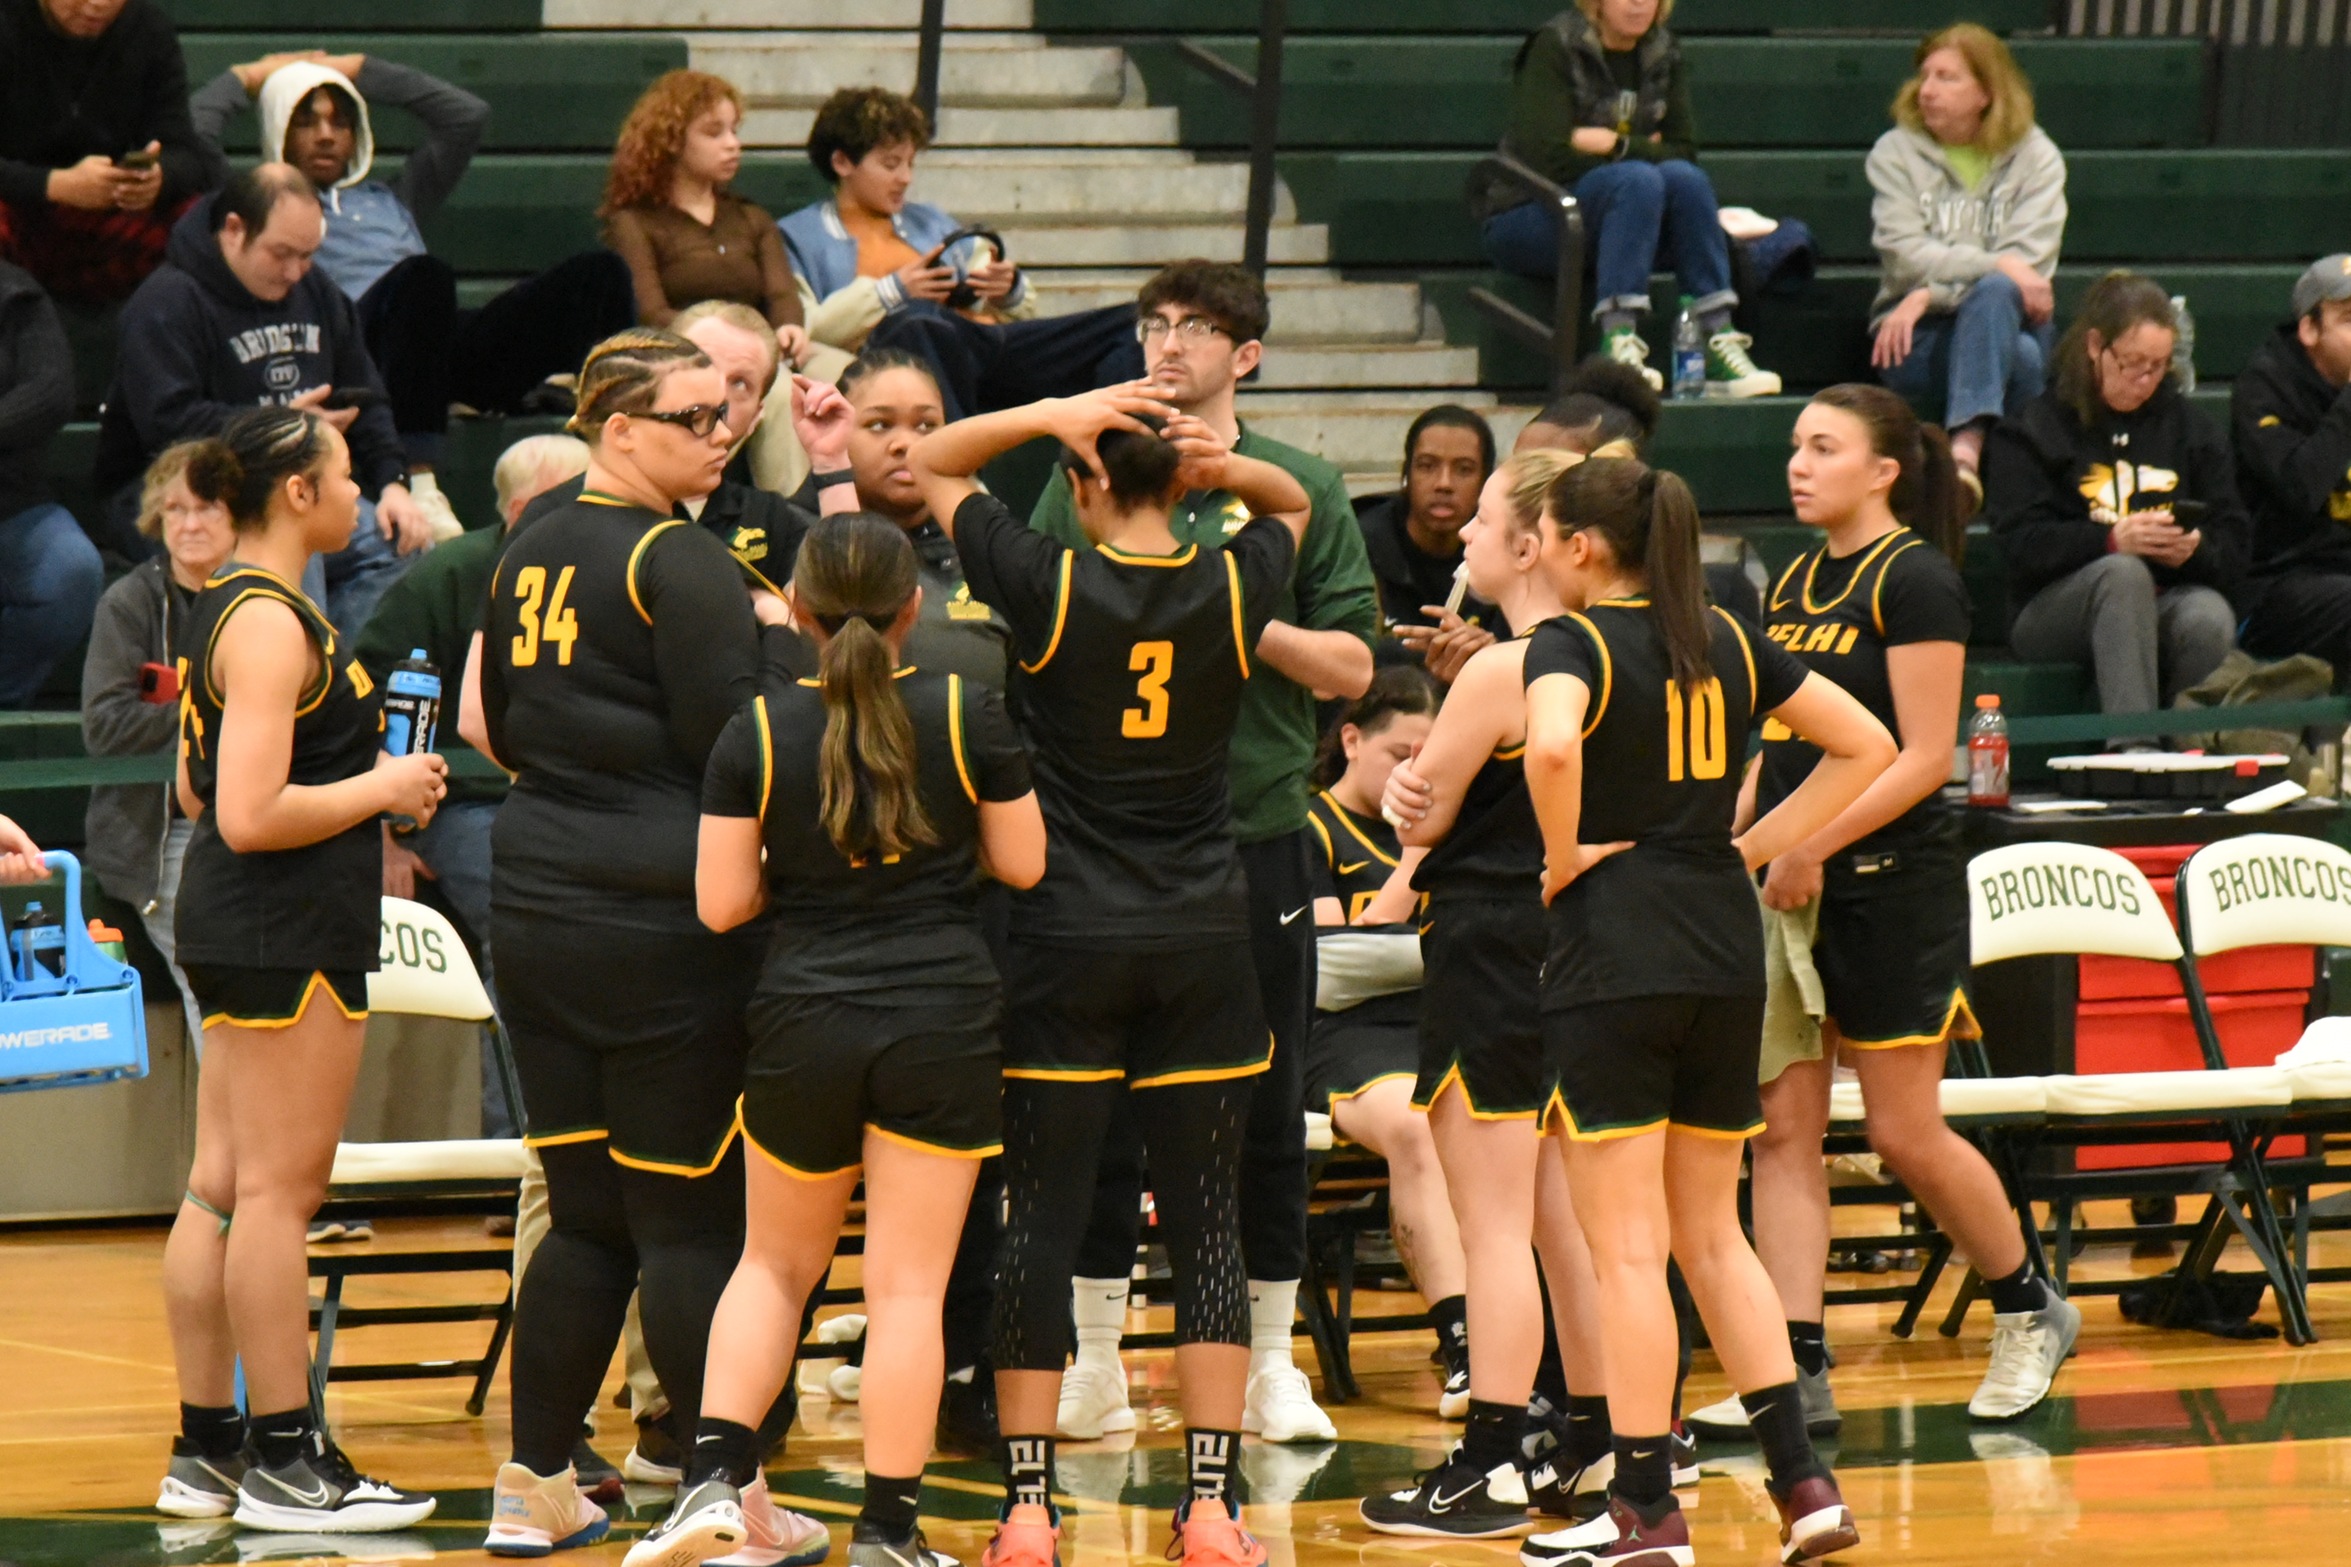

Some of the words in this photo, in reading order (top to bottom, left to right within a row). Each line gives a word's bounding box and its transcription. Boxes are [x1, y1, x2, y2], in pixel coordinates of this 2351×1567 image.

[511, 565, 578, 667] 34
[1121, 640, 1174, 739] 3
[1665, 675, 1727, 782] 10
[1980, 864, 2141, 922] BRONCOS
[2208, 856, 2351, 913] BRONCOS
[0, 1021, 110, 1051] WERADE
